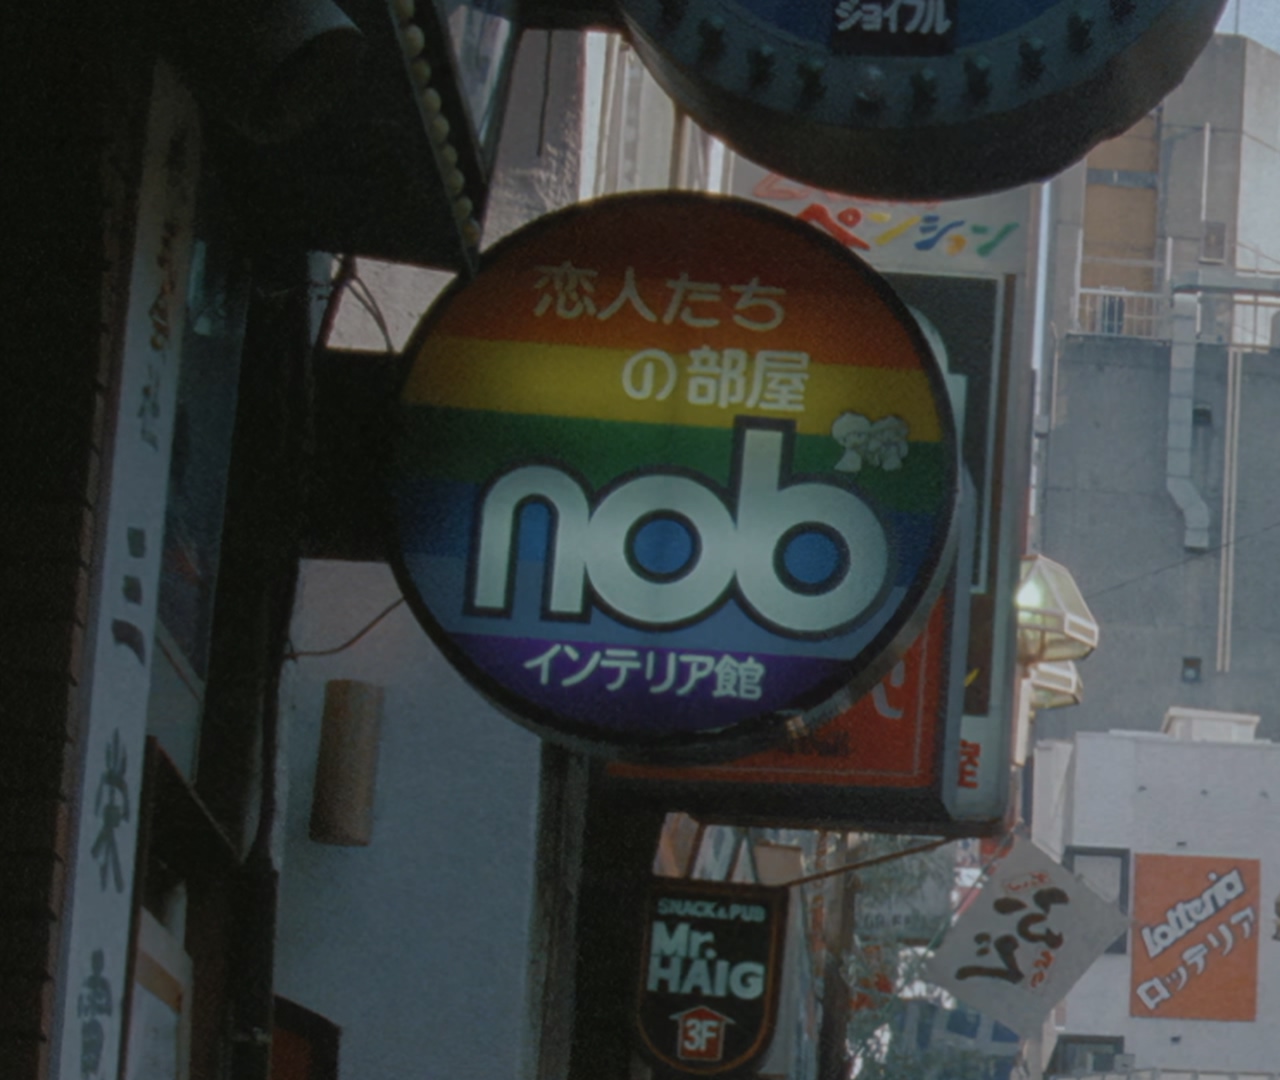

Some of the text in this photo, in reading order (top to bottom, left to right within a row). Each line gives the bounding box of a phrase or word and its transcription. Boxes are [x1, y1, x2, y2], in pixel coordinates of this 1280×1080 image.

[532, 260, 786, 331] 恋人たち
[621, 345, 811, 411] の部屋
[467, 421, 893, 638] nob
[524, 644, 766, 700] インテリア館
[652, 920, 717, 960] Mr.
[1136, 907, 1255, 1010] ロッテリア
[647, 955, 765, 999] HAIG
[683, 1018, 719, 1051] 3F
